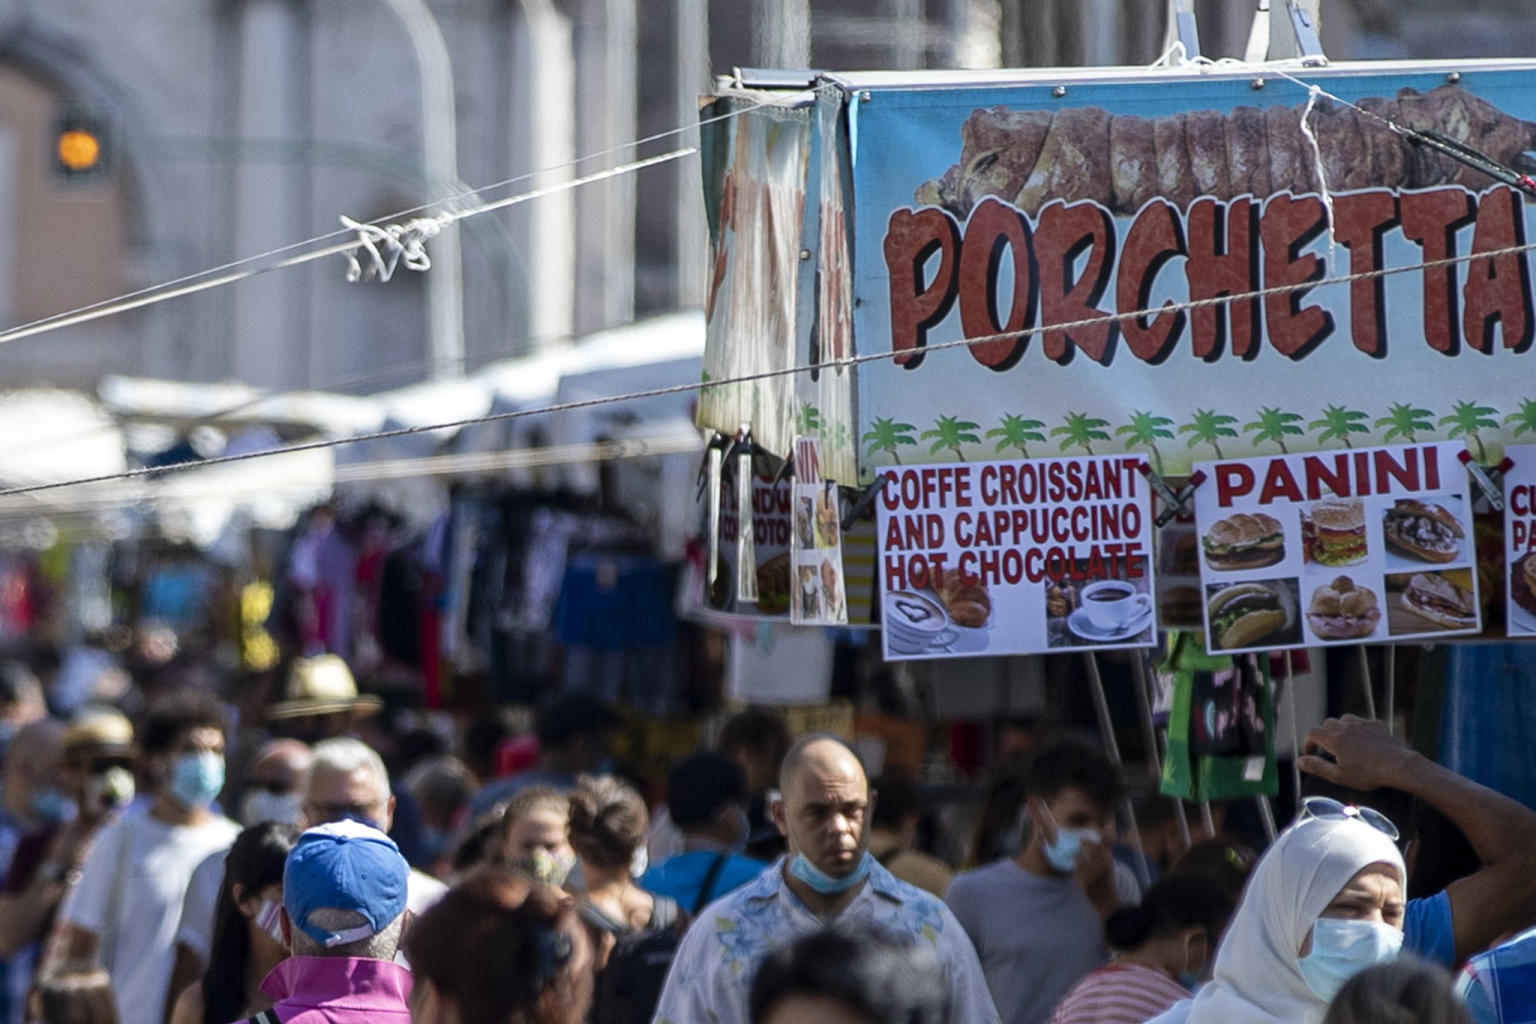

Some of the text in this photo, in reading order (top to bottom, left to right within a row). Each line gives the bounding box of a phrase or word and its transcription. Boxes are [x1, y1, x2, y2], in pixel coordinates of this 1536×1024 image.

[884, 186, 1534, 371] PORCHETTA
[882, 468, 972, 511] COFFE
[981, 458, 1140, 505] CROISSANT
[1215, 446, 1441, 508] PANINI
[885, 513, 945, 552] AND
[954, 503, 1142, 547] CAPPUCCINO
[885, 542, 1144, 592] HOT CHOCOLATE
